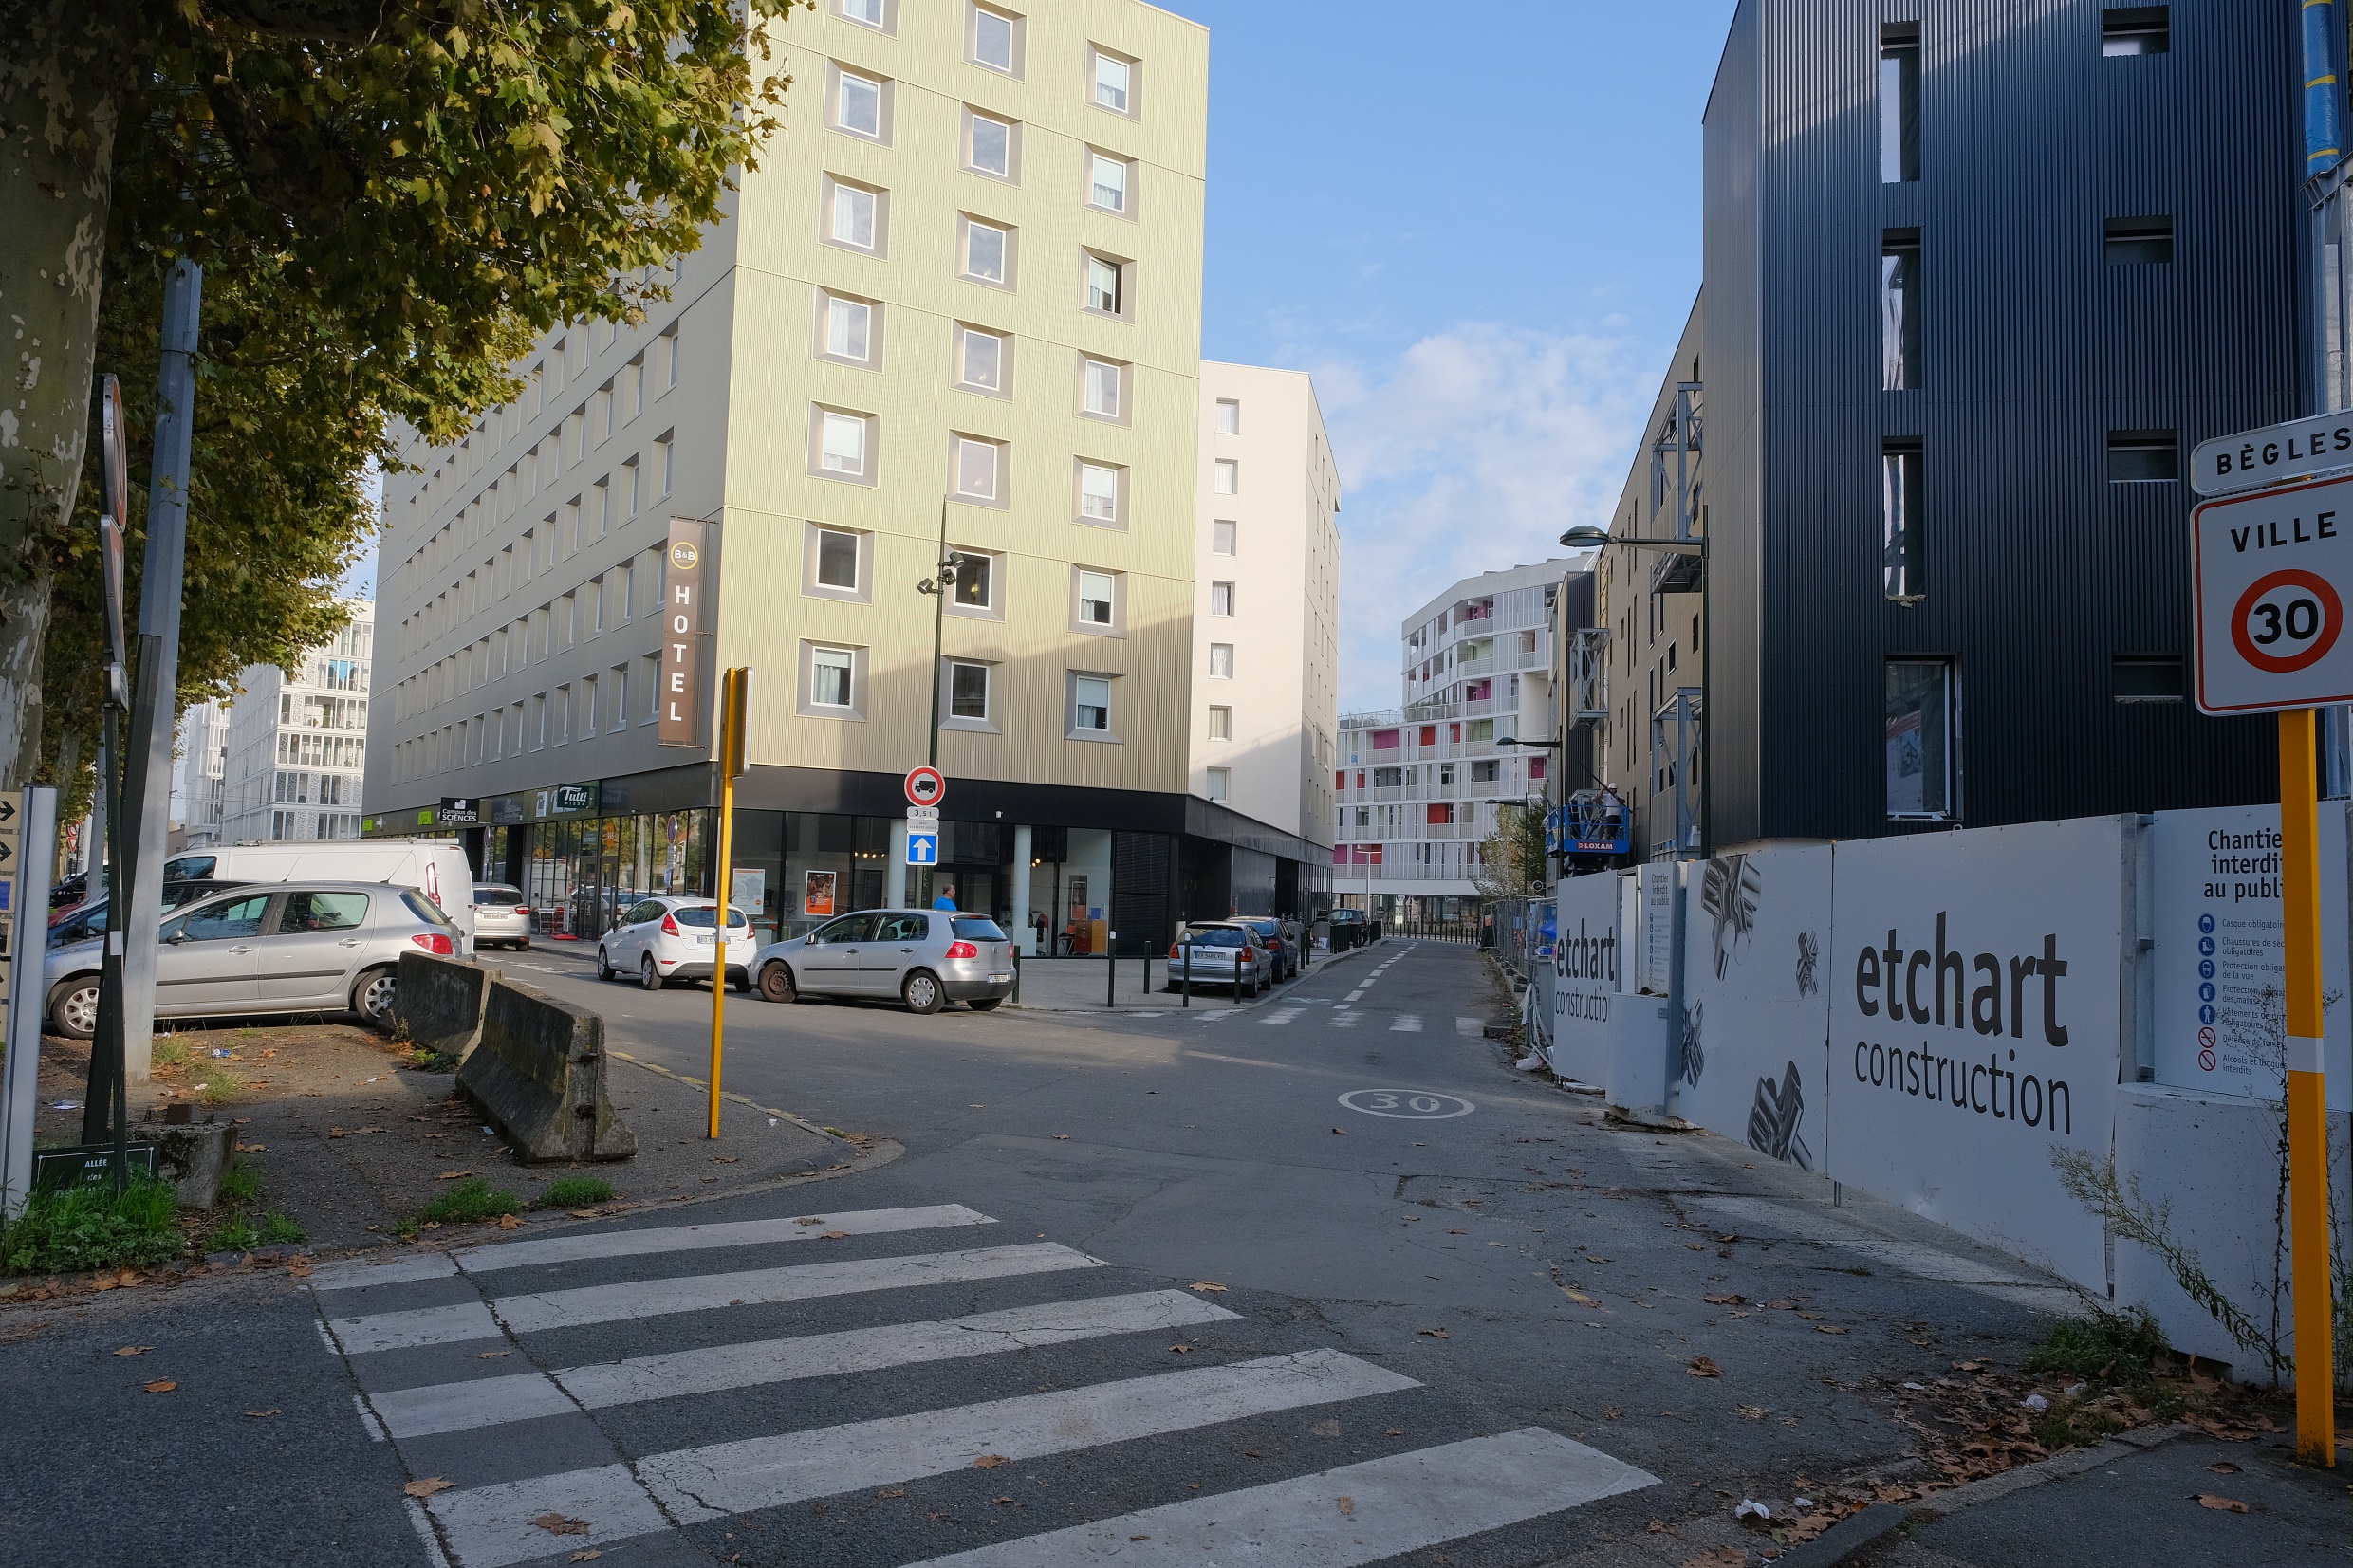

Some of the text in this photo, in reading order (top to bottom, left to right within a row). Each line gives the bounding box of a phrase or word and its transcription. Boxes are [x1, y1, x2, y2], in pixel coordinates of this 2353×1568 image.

[2216, 427, 2352, 475] BÈGLES
[2231, 511, 2337, 552] VILLE
[675, 549, 695, 560] B&B
[2253, 599, 2319, 644] 30
[670, 585, 690, 721] HOTEL
[560, 786, 587, 802] Tutti
[2208, 827, 2282, 850] Chantie
[2212, 852, 2282, 874] interdi
[2204, 876, 2283, 904] au publ
[2222, 918, 2246, 929] Casque
[1557, 917, 1615, 982] etchart
[2222, 937, 2260, 947] Chaussures
[2262, 938, 2271, 947] de
[2222, 947, 2264, 957] obligatoires
[2223, 961, 2285, 973] Protection obligat
[1856, 911, 2068, 1047] etchart
[1556, 985, 1610, 1023] constructio
[2222, 1054, 2247, 1064] Alcools
[2250, 1057, 2257, 1066] et
[2223, 1063, 2252, 1075] interdits
[1855, 1041, 2070, 1134] construction
[1370, 1093, 1441, 1113] 30
[84, 1157, 108, 1168] ALLÉE
